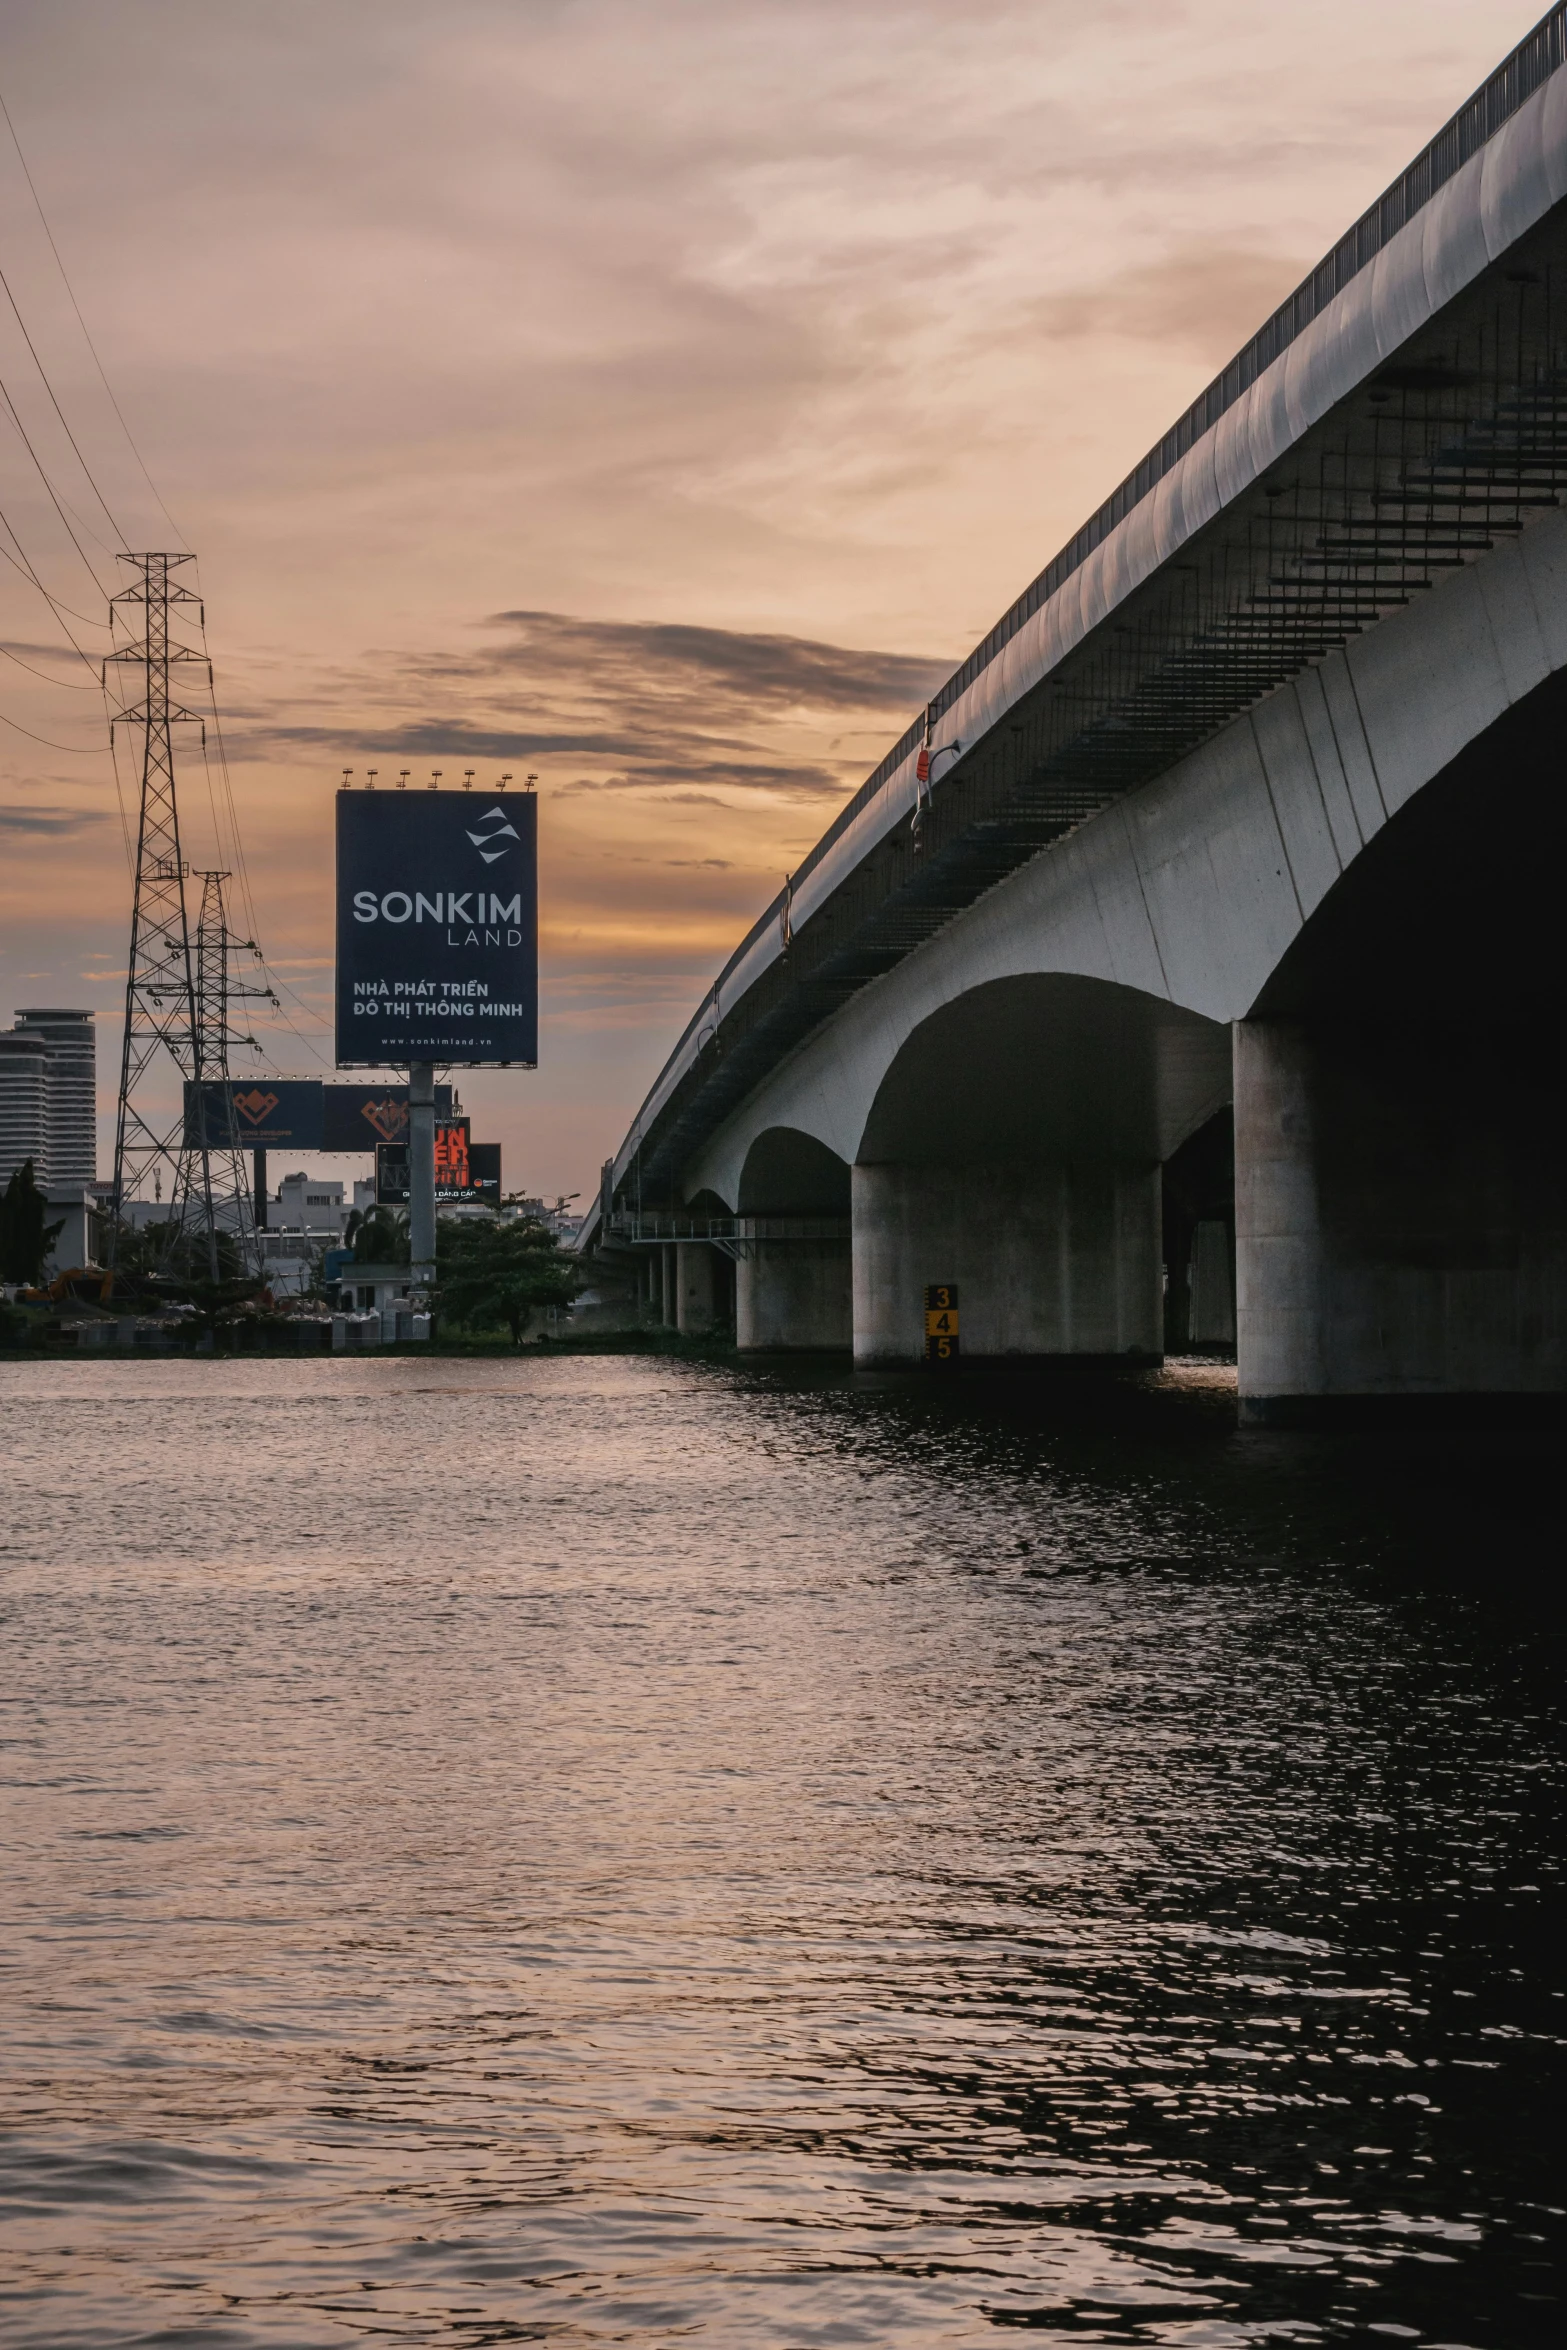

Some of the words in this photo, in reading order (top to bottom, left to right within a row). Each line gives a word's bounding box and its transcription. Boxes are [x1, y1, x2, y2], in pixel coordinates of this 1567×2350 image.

[353, 891, 522, 925] SONKIM
[447, 928, 522, 947] LAND
[353, 979, 390, 996] NHÀ
[394, 980, 437, 996] PHÁT
[441, 979, 489, 997] TRIỂN
[353, 998, 379, 1015] ĐÔ
[383, 1002, 410, 1019] THỊ
[415, 999, 475, 1016] THÔNG
[479, 1003, 523, 1017] MINH
[936, 1287, 950, 1309] 3
[936, 1312, 951, 1333] 4
[937, 1337, 951, 1359] 5
